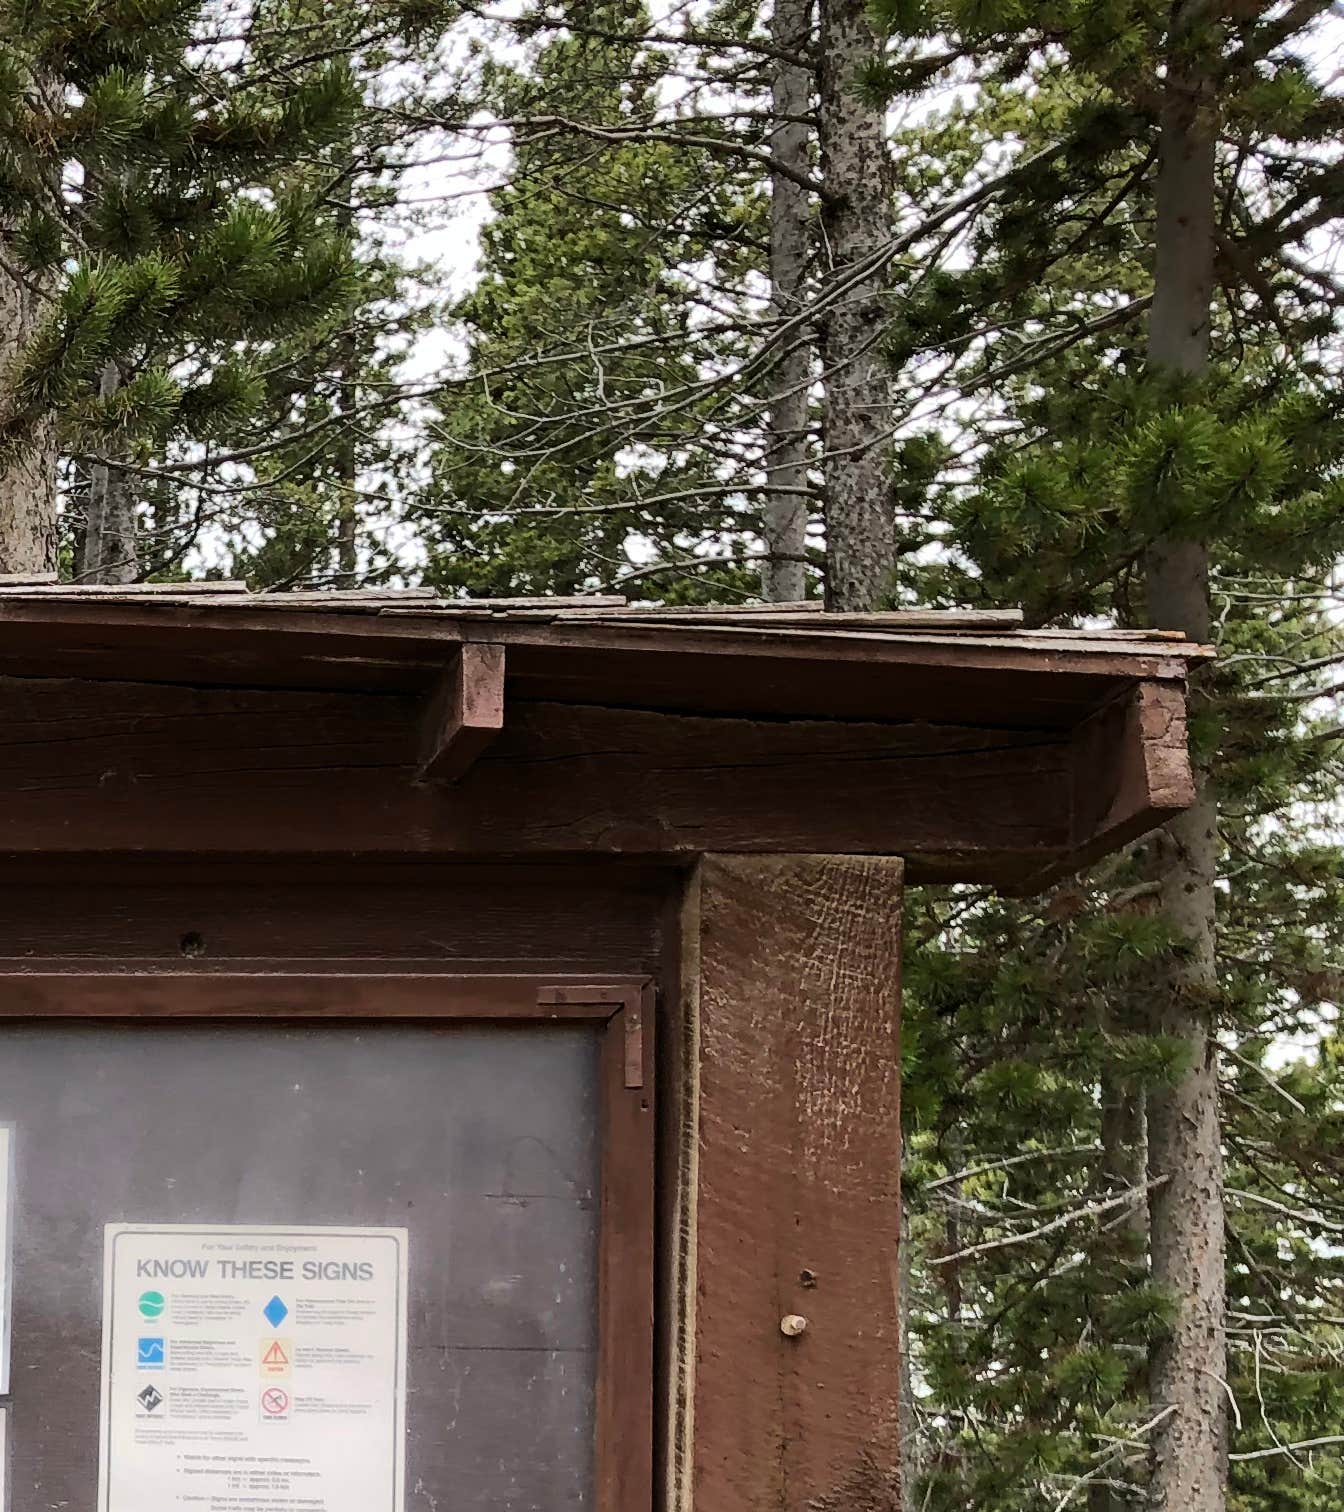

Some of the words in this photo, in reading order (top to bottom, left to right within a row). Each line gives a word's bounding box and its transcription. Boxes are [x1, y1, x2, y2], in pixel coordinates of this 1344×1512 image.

[136, 1258, 209, 1279] KNOW
[217, 1260, 294, 1280] THESE
[302, 1261, 374, 1281] SIGNS
